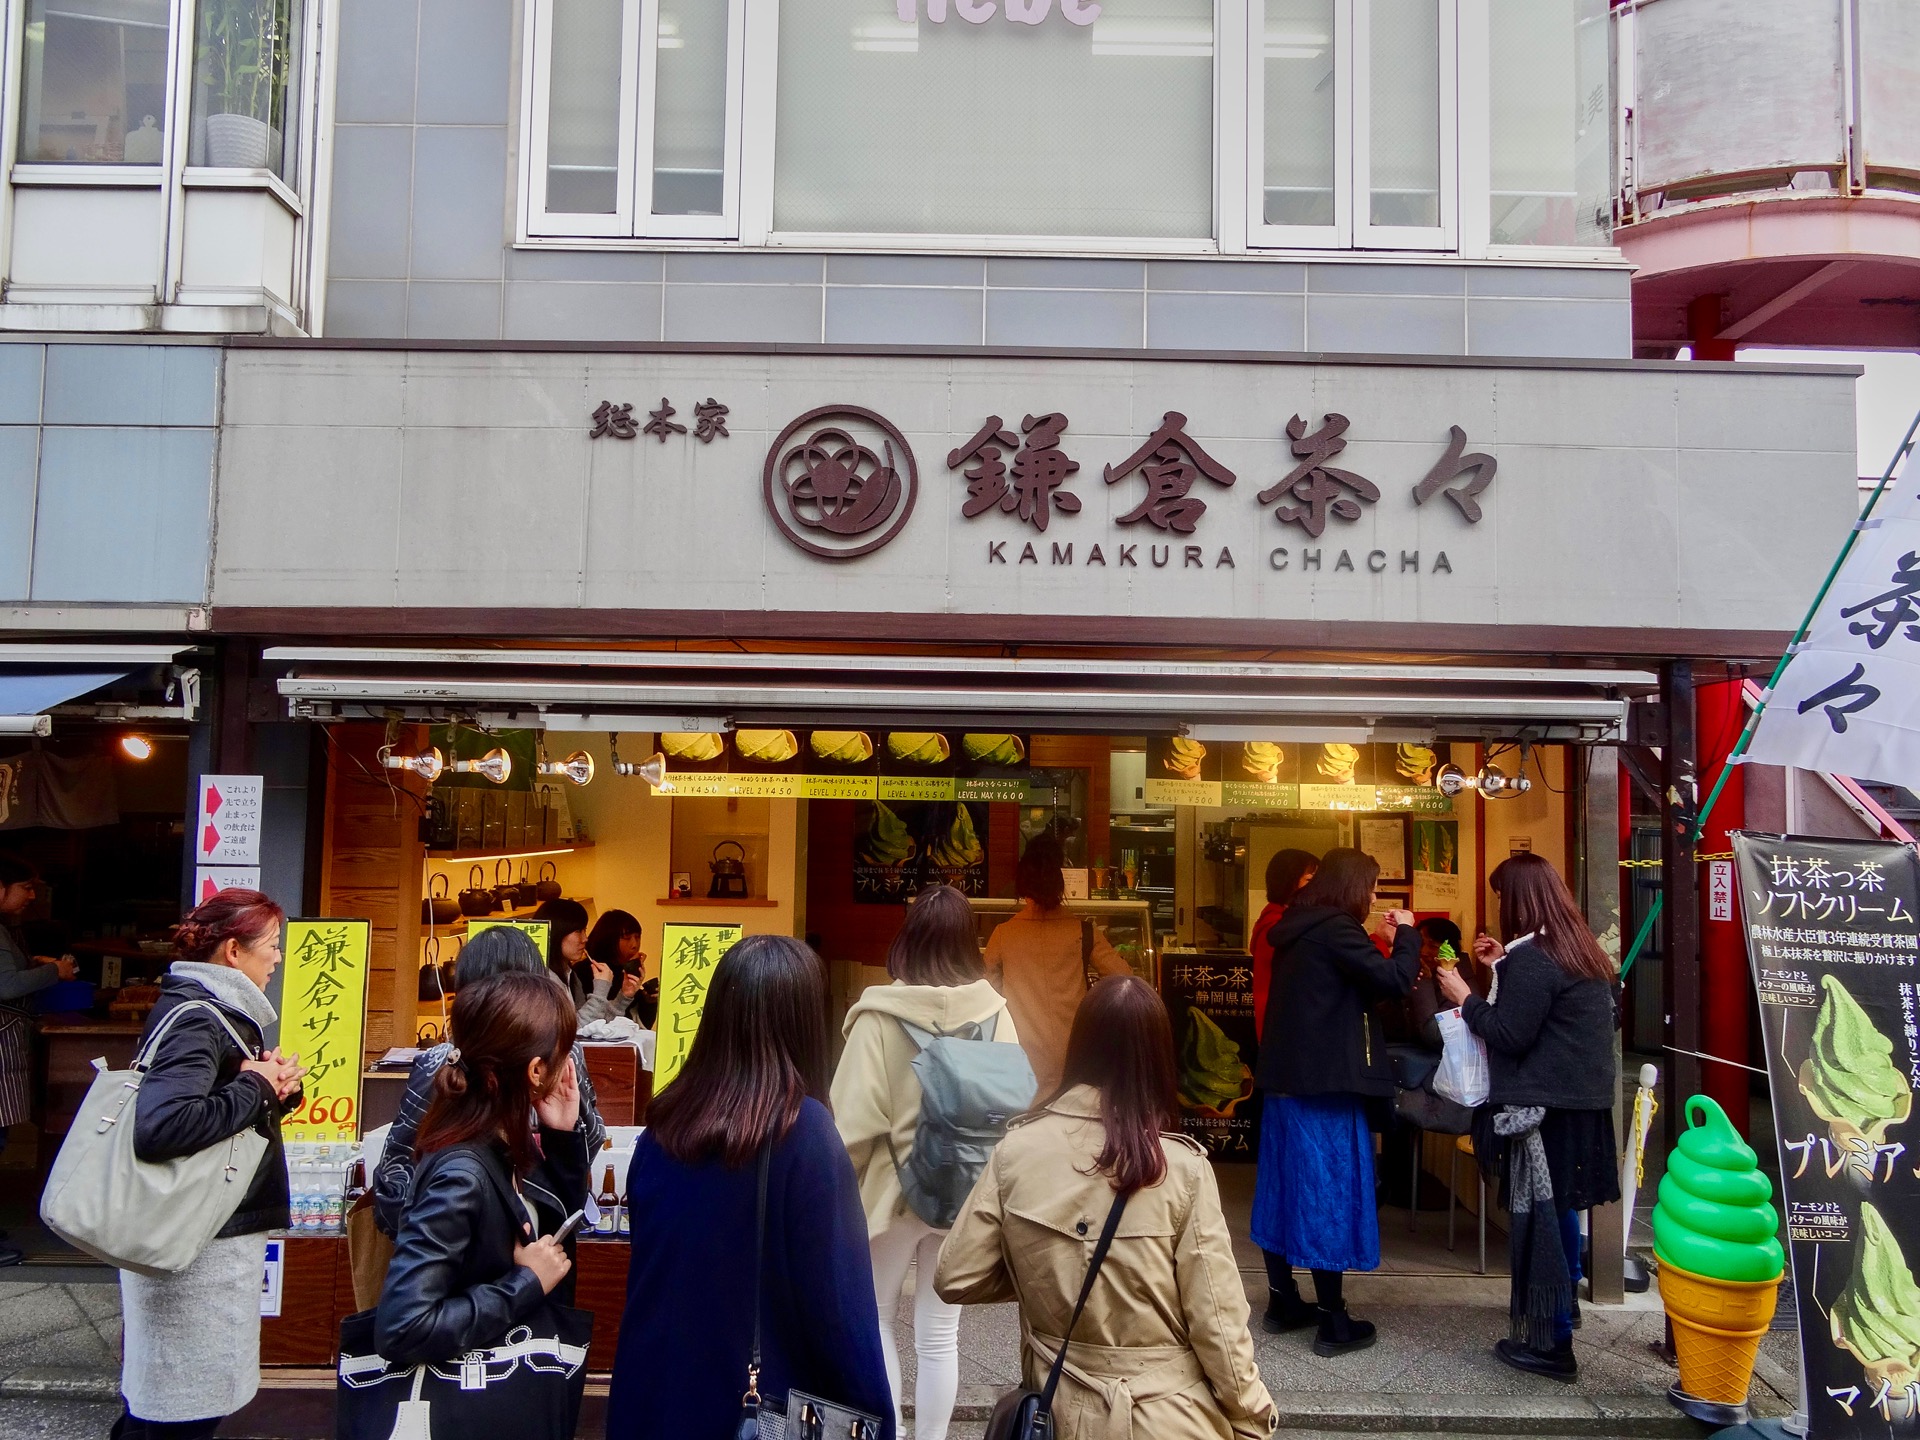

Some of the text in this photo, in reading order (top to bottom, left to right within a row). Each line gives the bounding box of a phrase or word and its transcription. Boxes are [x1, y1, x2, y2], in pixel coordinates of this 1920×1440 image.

[590, 397, 730, 444] 総本家
[947, 410, 1497, 538] 鎌倉茶々
[988, 541, 1453, 573] KAMAKURA CHACHA
[226, 786, 257, 794] これより
[734, 786, 792, 795] LEVEL 2 ¥450
[809, 788, 867, 797] LEVEL 3 ¥500
[887, 790, 945, 799] LEVEL 4 ¥550
[958, 791, 1024, 800] LEVEL MAX ¥600
[225, 798, 257, 807] 先で立ち
[1187, 796, 1213, 805] ¥500
[1227, 798, 1289, 807] プレミアム ¥600
[1420, 801, 1445, 809] ¥600
[225, 811, 256, 819] 止まって
[223, 823, 255, 832] の飲食は
[223, 836, 247, 845] ご遠慮
[1770, 855, 1886, 893] 抹茶っ茶
[223, 877, 254, 886] これより
[857, 878, 918, 893] プレミアム
[1713, 864, 1727, 919] 立入禁止
[1752, 890, 1914, 924] ソフトクリーム
[1761, 944, 1917, 966] 極上本抹茶を贅沢に振りかけます
[1172, 964, 1254, 990] 抹茶っ茶
[1761, 968, 1808, 981] アーモンドと
[1758, 981, 1816, 993] バターの風味が
[1760, 992, 1816, 1004] 美味しいコーン
[294, 926, 355, 1099] 鎌倉サイダー
[1784, 1132, 1920, 1184] プレミア
[1791, 1201, 1841, 1213] アーモンドと
[1789, 1214, 1848, 1228] バターの風味が
[1790, 1227, 1849, 1240] 美味しいコーン
